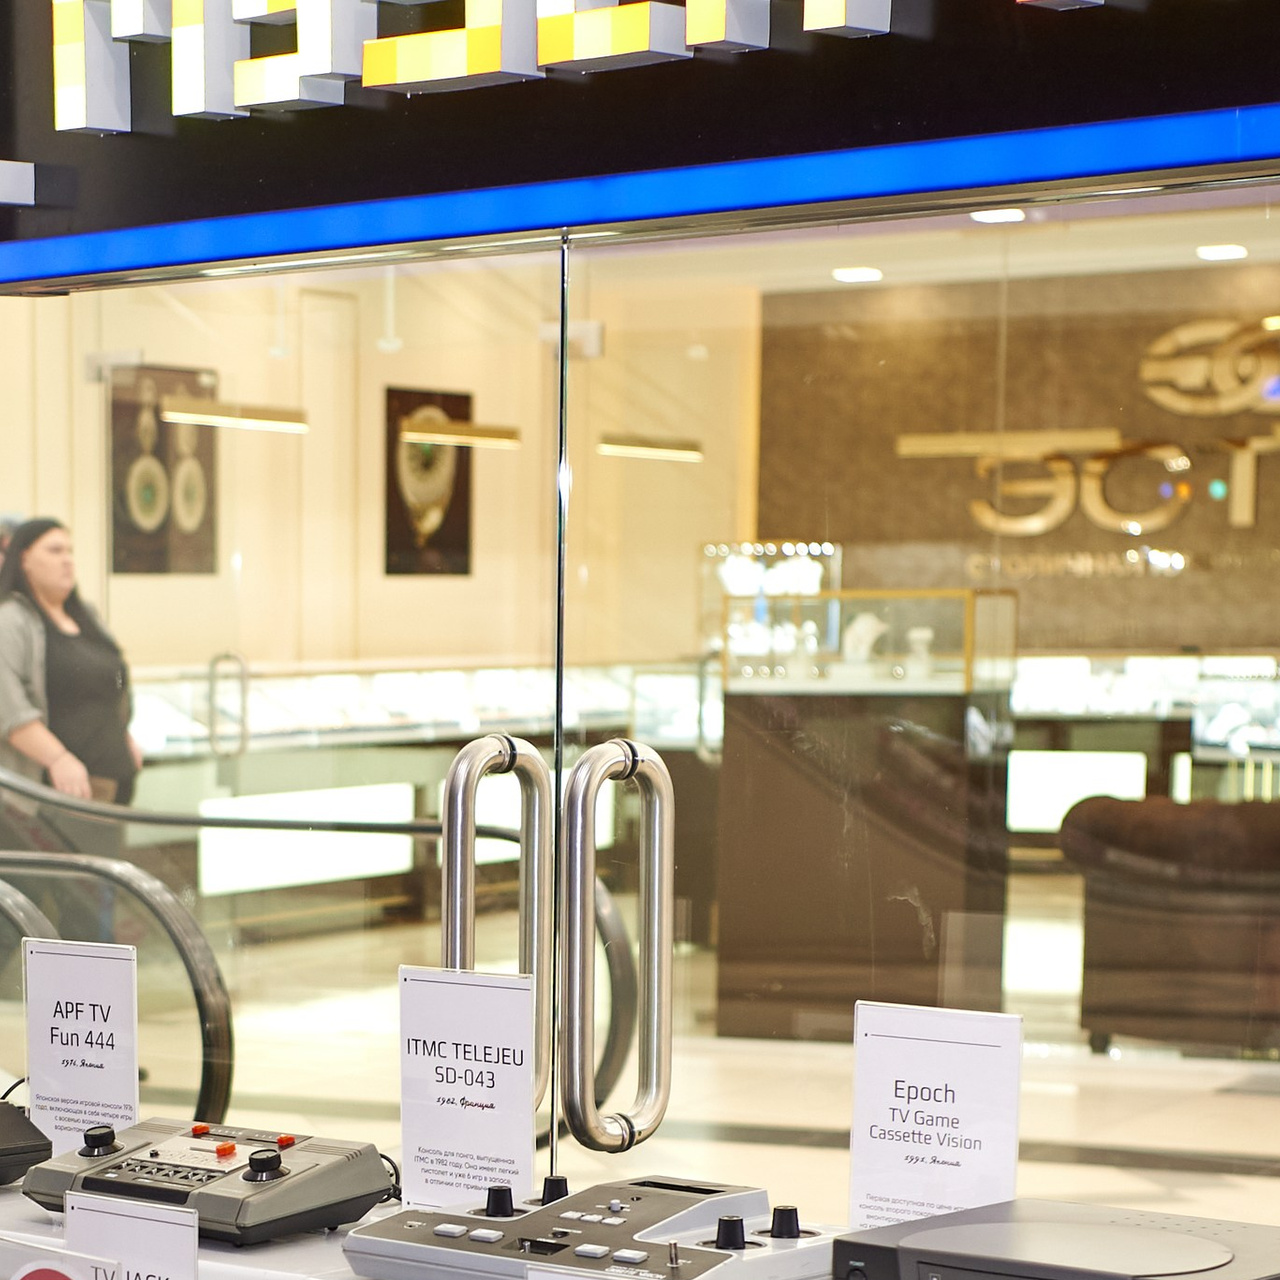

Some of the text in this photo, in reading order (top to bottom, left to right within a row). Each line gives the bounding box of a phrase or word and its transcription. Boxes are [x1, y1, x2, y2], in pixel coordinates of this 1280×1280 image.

[53, 1000, 111, 1023] APF TV
[50, 1026, 115, 1050] Fun 444
[406, 1038, 524, 1067] ITMC TELEJEU
[435, 1065, 496, 1089] SD-043
[894, 1079, 956, 1104] Epoch
[889, 1107, 960, 1129] TV Game
[869, 1124, 982, 1150] Cassette Vision
[418, 1146, 443, 1156] Консоль
